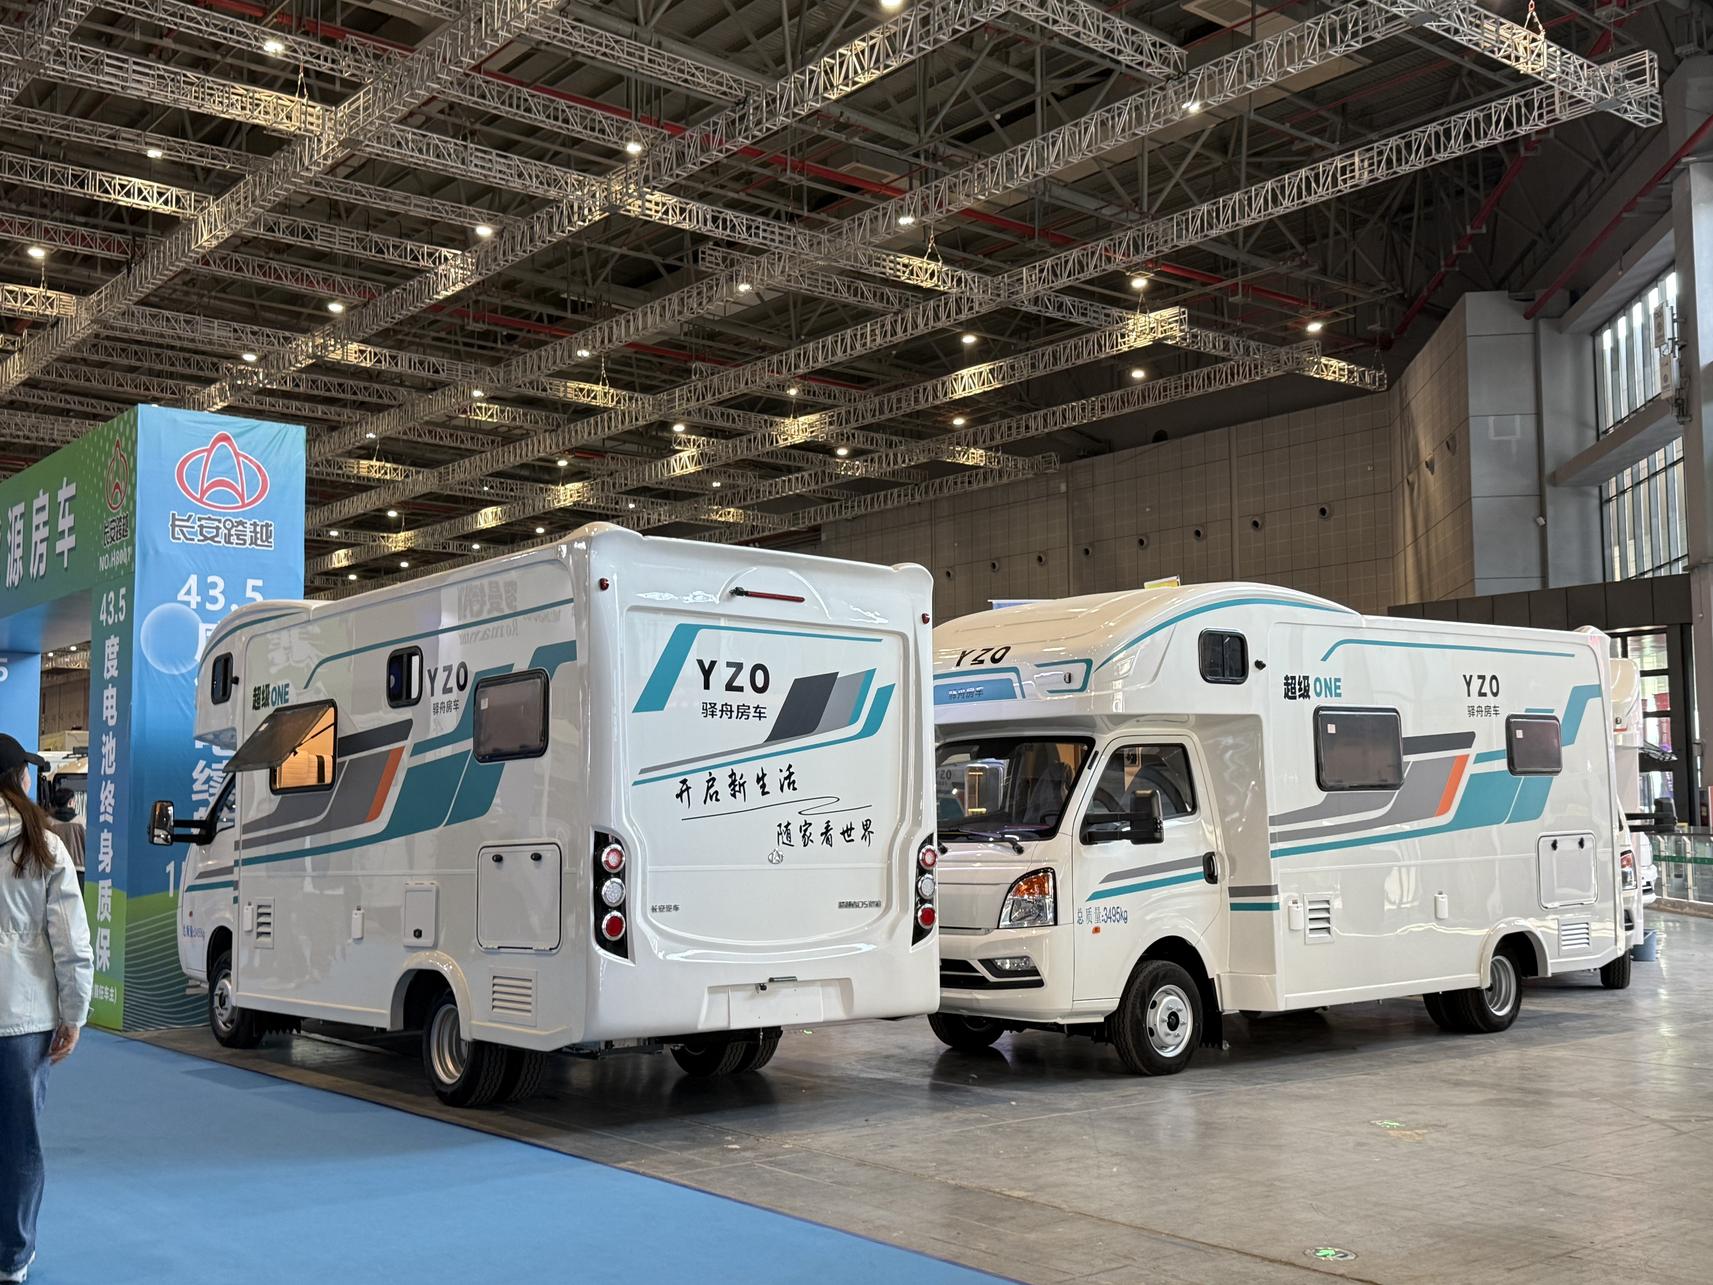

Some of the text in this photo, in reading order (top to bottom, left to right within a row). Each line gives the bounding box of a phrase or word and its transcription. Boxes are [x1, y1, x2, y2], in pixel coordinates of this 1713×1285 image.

[6, 476, 76, 588] 源房车
[169, 511, 274, 550] 长安跨越
[99, 587, 127, 627] 43.5
[955, 645, 1011, 667] YZO
[427, 661, 468, 697] YZO
[696, 658, 770, 694] YZO
[1462, 674, 1500, 697] YZO
[432, 699, 460, 716] 驿舟房车
[701, 701, 767, 721] 驿舟房车
[1467, 704, 1500, 718] 驿舟房车
[95, 634, 120, 972] 度电池终身质保
[675, 763, 798, 809] 开启新生活
[776, 817, 875, 848] 随家看世界
